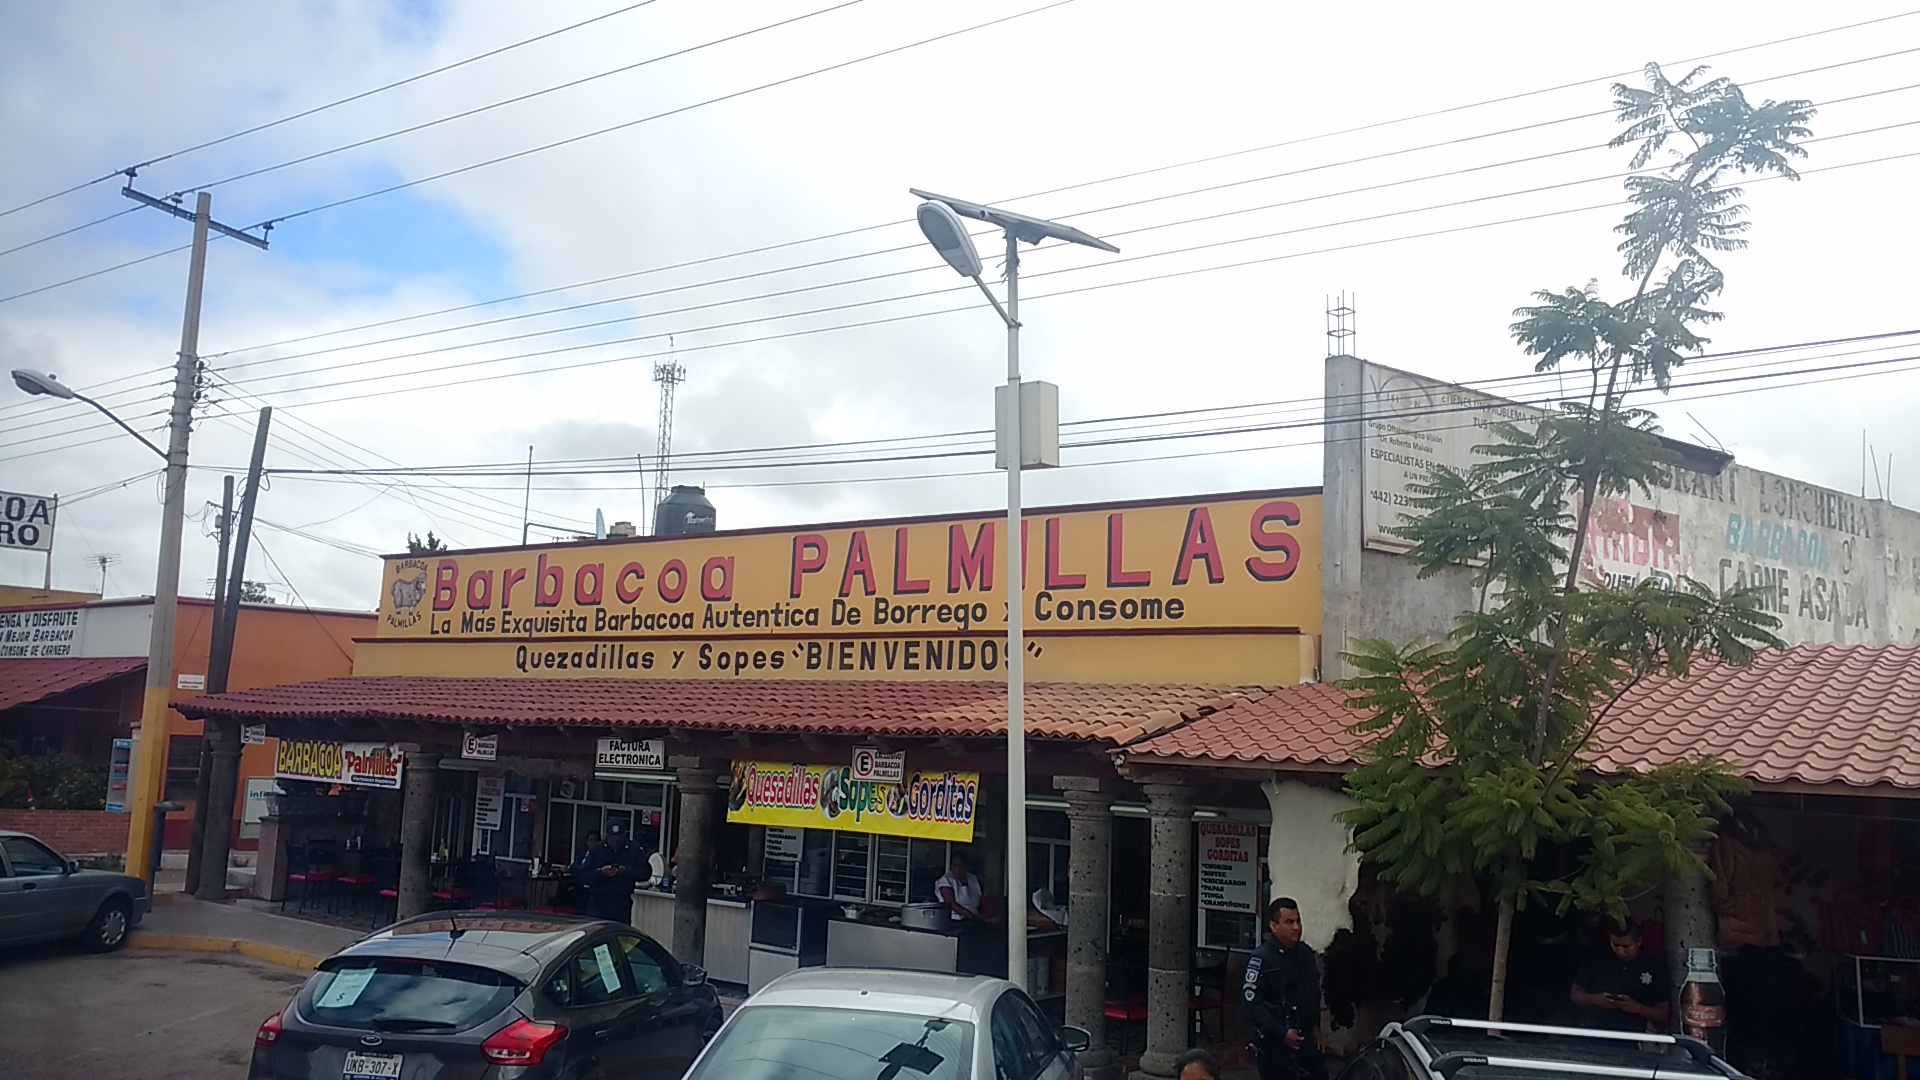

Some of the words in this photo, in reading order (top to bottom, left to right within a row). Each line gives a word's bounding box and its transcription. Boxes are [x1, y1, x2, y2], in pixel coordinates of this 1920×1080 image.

[1368, 420, 1386, 432] Grupo
[1389, 437, 1412, 449] Roberto
[1370, 448, 1424, 469] ESPECIALISTAS
[0, 496, 50, 525] OA
[432, 552, 736, 612] Barbacoa
[790, 501, 1301, 598] PALMILLAS
[396, 560, 428, 574] BARBACOA
[25, 613, 31, 627] Y
[32, 611, 78, 627] DISFRUTE
[387, 611, 422, 628] PALMILLAS
[430, 613, 451, 635] La
[501, 610, 587, 637] Exquisita
[594, 606, 694, 632] Barbacoa
[702, 602, 819, 630] Autentica
[831, 598, 862, 626] De
[873, 597, 988, 631] Borrego
[1034, 591, 1185, 621] Consome
[5, 630, 30, 643] MEJOR
[32, 629, 74, 642] BARBACOA
[515, 643, 655, 673] Quezadillas
[671, 650, 685, 669] y
[698, 643, 785, 676] Sopes
[791, 640, 1044, 672] "BIENVENIDO"
[468, 738, 474, 751] E
[610, 740, 651, 752] FACTURA
[278, 739, 343, 779] BARBACOA
[598, 753, 661, 765] ELECTRONICA
[861, 755, 870, 771] E
[875, 761, 901, 769] BARBACOA
[873, 769, 900, 778] PALMILLAS
[747, 764, 820, 812] Quesadillas
[839, 766, 886, 824] Sopes
[908, 769, 977, 825] Gorditas
[1200, 823, 1256, 837] QUESADILLAS
[1215, 837, 1240, 849] SOPES
[1207, 848, 1249, 863] GORDITAS
[345, 1059, 399, 1076] UKB-307-X
